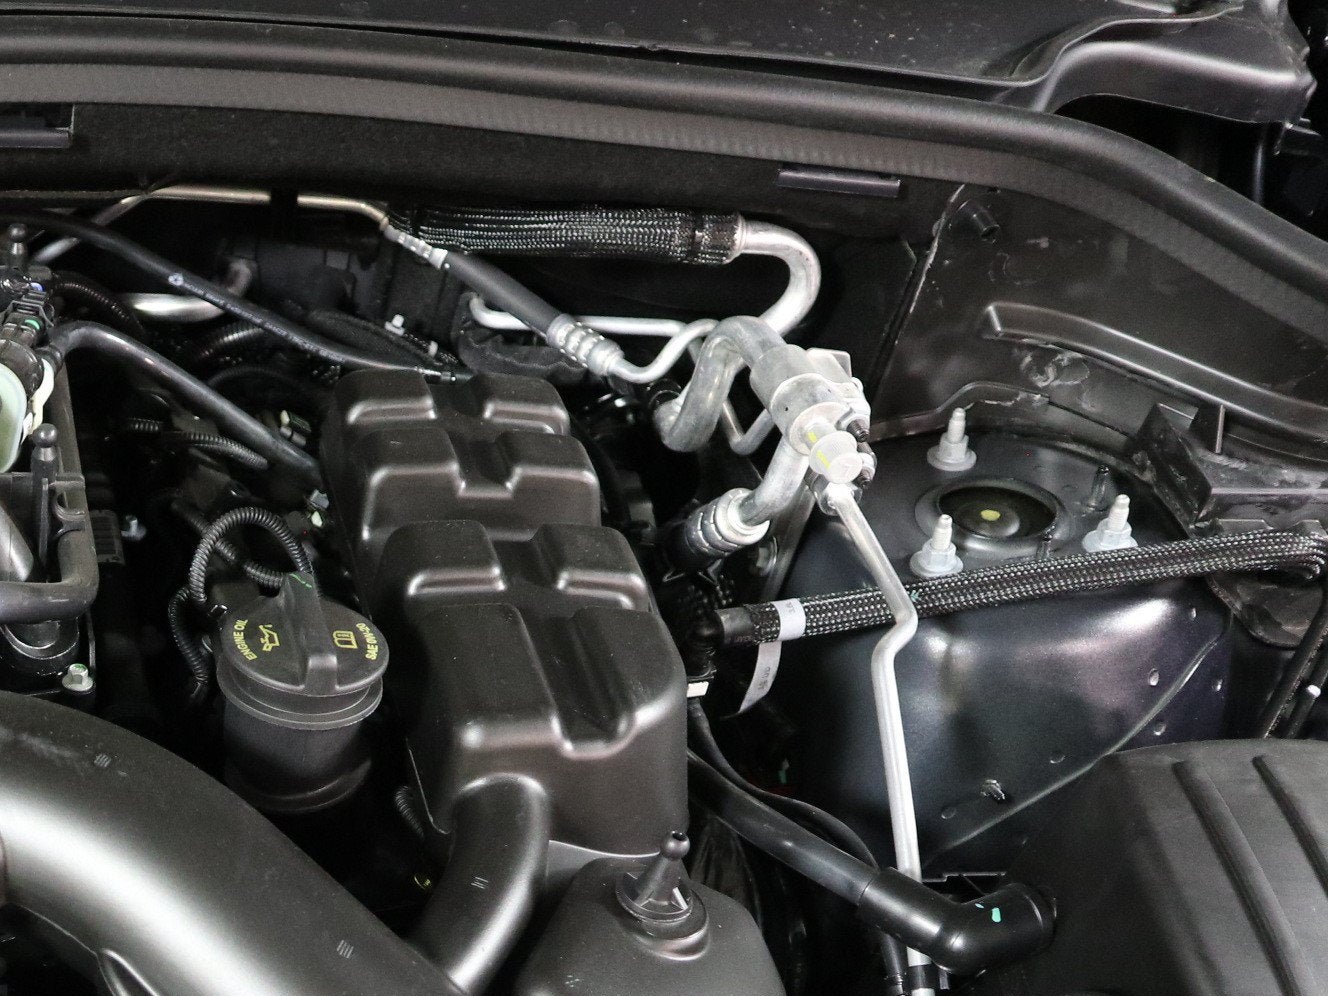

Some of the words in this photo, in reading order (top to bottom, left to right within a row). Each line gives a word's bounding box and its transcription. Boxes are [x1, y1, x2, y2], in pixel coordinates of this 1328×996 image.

[234, 619, 248, 630] OIL
[233, 632, 257, 660] ENGINE
[365, 645, 379, 660] SAE
